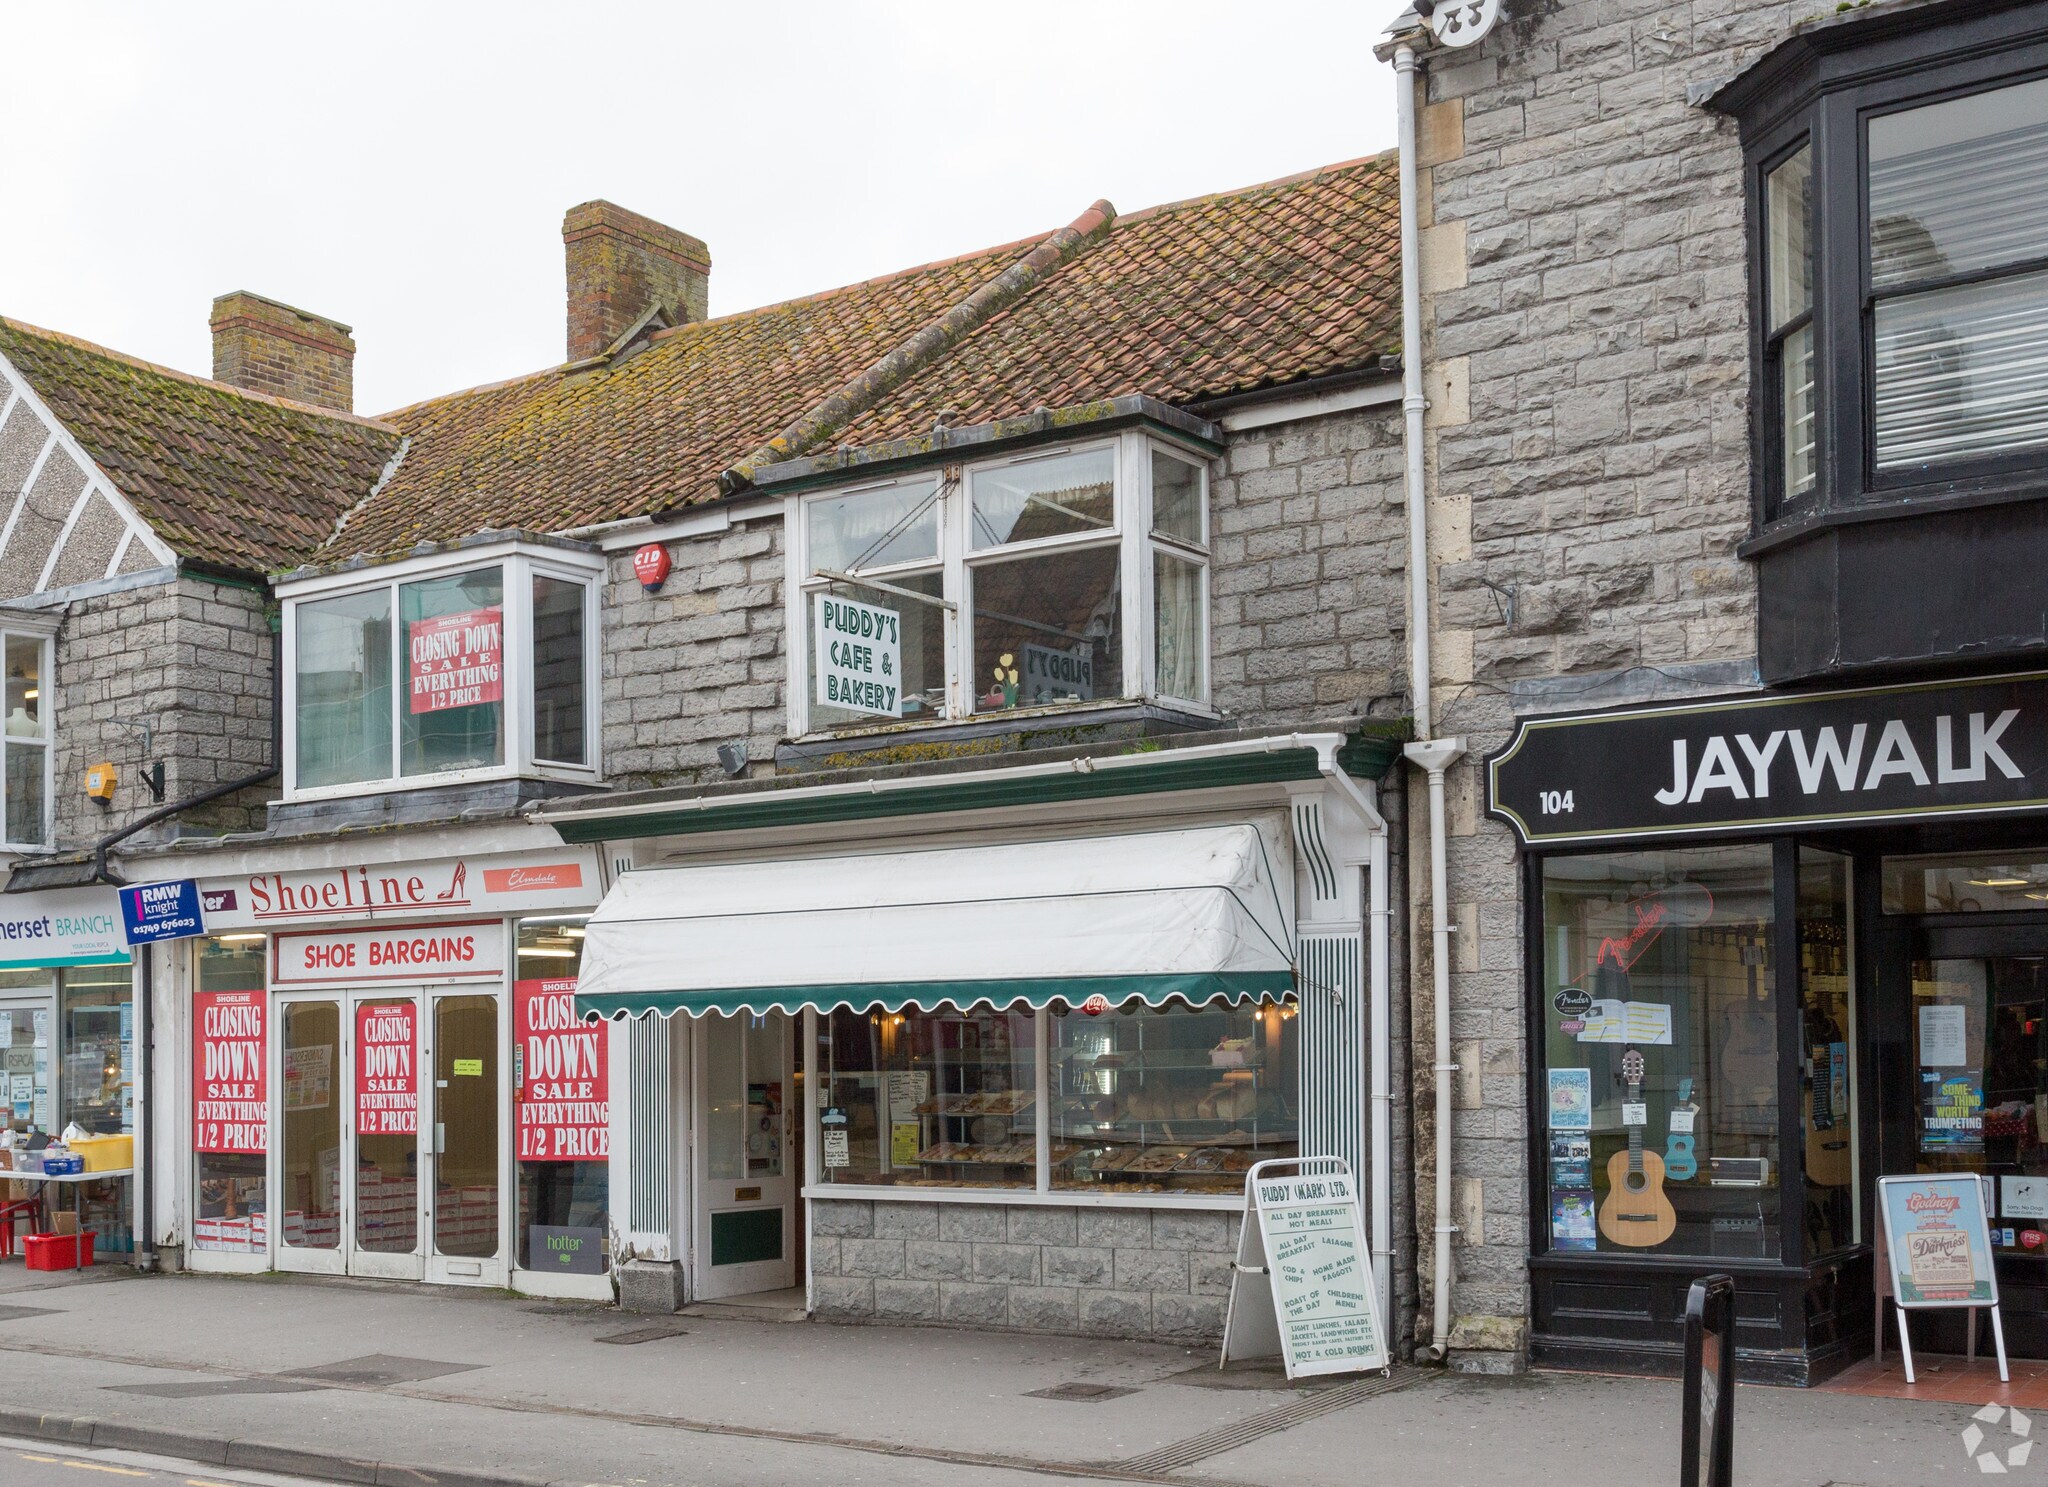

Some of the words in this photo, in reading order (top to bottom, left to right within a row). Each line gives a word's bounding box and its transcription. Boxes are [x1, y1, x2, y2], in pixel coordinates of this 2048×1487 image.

[438, 615, 472, 627] SHOELINE
[823, 600, 897, 645] PUDDY'S
[412, 629, 460, 664] CLOSING
[464, 622, 499, 655] DOWN
[421, 652, 491, 674] SALE
[830, 640, 873, 674] CAFE
[881, 652, 893, 676] &
[414, 663, 499, 695] EVERYTHING
[431, 691, 446, 709] 1/2
[449, 686, 481, 706] PRICE
[827, 674, 897, 712] BAKERY
[1653, 708, 2026, 806] JAYWALK
[1539, 789, 1575, 815] 104
[507, 868, 557, 887] Elmdale
[141, 884, 181, 903] RMW
[249, 867, 426, 913] Shoeline
[143, 899, 179, 915] knight
[56, 915, 115, 937] BRANCH
[133, 923, 160, 935] 01749
[161, 917, 195, 931] 676023
[304, 943, 356, 969] SHOE
[369, 935, 475, 966] BARGAINS
[542, 982, 578, 991] SHOELIN
[216, 995, 250, 1003] SHOELINE
[1556, 992, 1589, 1006] Fender
[204, 1005, 261, 1038] CLOSING
[364, 1016, 411, 1043] CLOSING
[204, 1040, 261, 1082] DOWN
[364, 1044, 411, 1078] DOWN
[528, 1033, 599, 1080] DOWN
[207, 1083, 255, 1099] SALE
[367, 1079, 407, 1092] SALE
[533, 1081, 593, 1100] SALE
[1942, 1083, 1973, 1096] SOME-
[360, 1092, 417, 1109] EVERYTHING
[1953, 1095, 1981, 1107] THING
[197, 1100, 267, 1121] EVERYTHING
[521, 1101, 609, 1125] EVERYTHING
[1936, 1106, 1969, 1118] WORTH
[360, 1111, 377, 1132] 1/2
[380, 1110, 417, 1132] PRICE
[1923, 1117, 1982, 1129] TRUMPETING
[197, 1122, 218, 1148] 1/2
[223, 1123, 267, 1150] PRICE
[521, 1127, 547, 1157] 1/2
[554, 1127, 609, 1156] PRICE
[1261, 1185, 1290, 1202] PUDDY
[1294, 1182, 1327, 1200] (MARK)
[1329, 1181, 1350, 1198] LTD.
[1910, 1193, 1955, 1212] Godney
[1271, 1213, 1284, 1221] ALL
[1306, 1208, 1347, 1218] BREAKFAST
[1289, 1220, 1305, 1228] HOT
[1309, 1218, 1333, 1227] MEALS
[547, 1235, 583, 1251] hotter
[1279, 1241, 1291, 1250] ALL
[1293, 1235, 1307, 1245] DAY
[1322, 1236, 1354, 1248] LASAGNE
[1913, 1233, 1965, 1259] Darkness
[2024, 1232, 2041, 1241] PRS
[1276, 1242, 1316, 1261] BREAKFAST
[1282, 1265, 1297, 1274] COD
[1312, 1262, 1334, 1276] HOME
[1336, 1255, 1356, 1268] MADE
[1322, 1265, 1353, 1282] FAGGOTS
[1284, 1274, 1303, 1284] CHIPS
[1284, 1295, 1307, 1309] ROAST
[1309, 1290, 1320, 1299] OF
[1327, 1289, 1364, 1301] CHILDRENS
[1335, 1299, 1356, 1309] MENU
[1289, 1306, 1304, 1317] THE
[1305, 1299, 1320, 1311] DAY
[1290, 1324, 1310, 1332] LIGHT
[1344, 1318, 1368, 1327] SALADS
[1320, 1328, 1358, 1338] SANDWICHES
[1360, 1326, 1372, 1334] ETC
[1294, 1350, 1312, 1360] HOT
[1324, 1347, 1344, 1357] COLD
[1346, 1344, 1375, 1355] DRINKS
